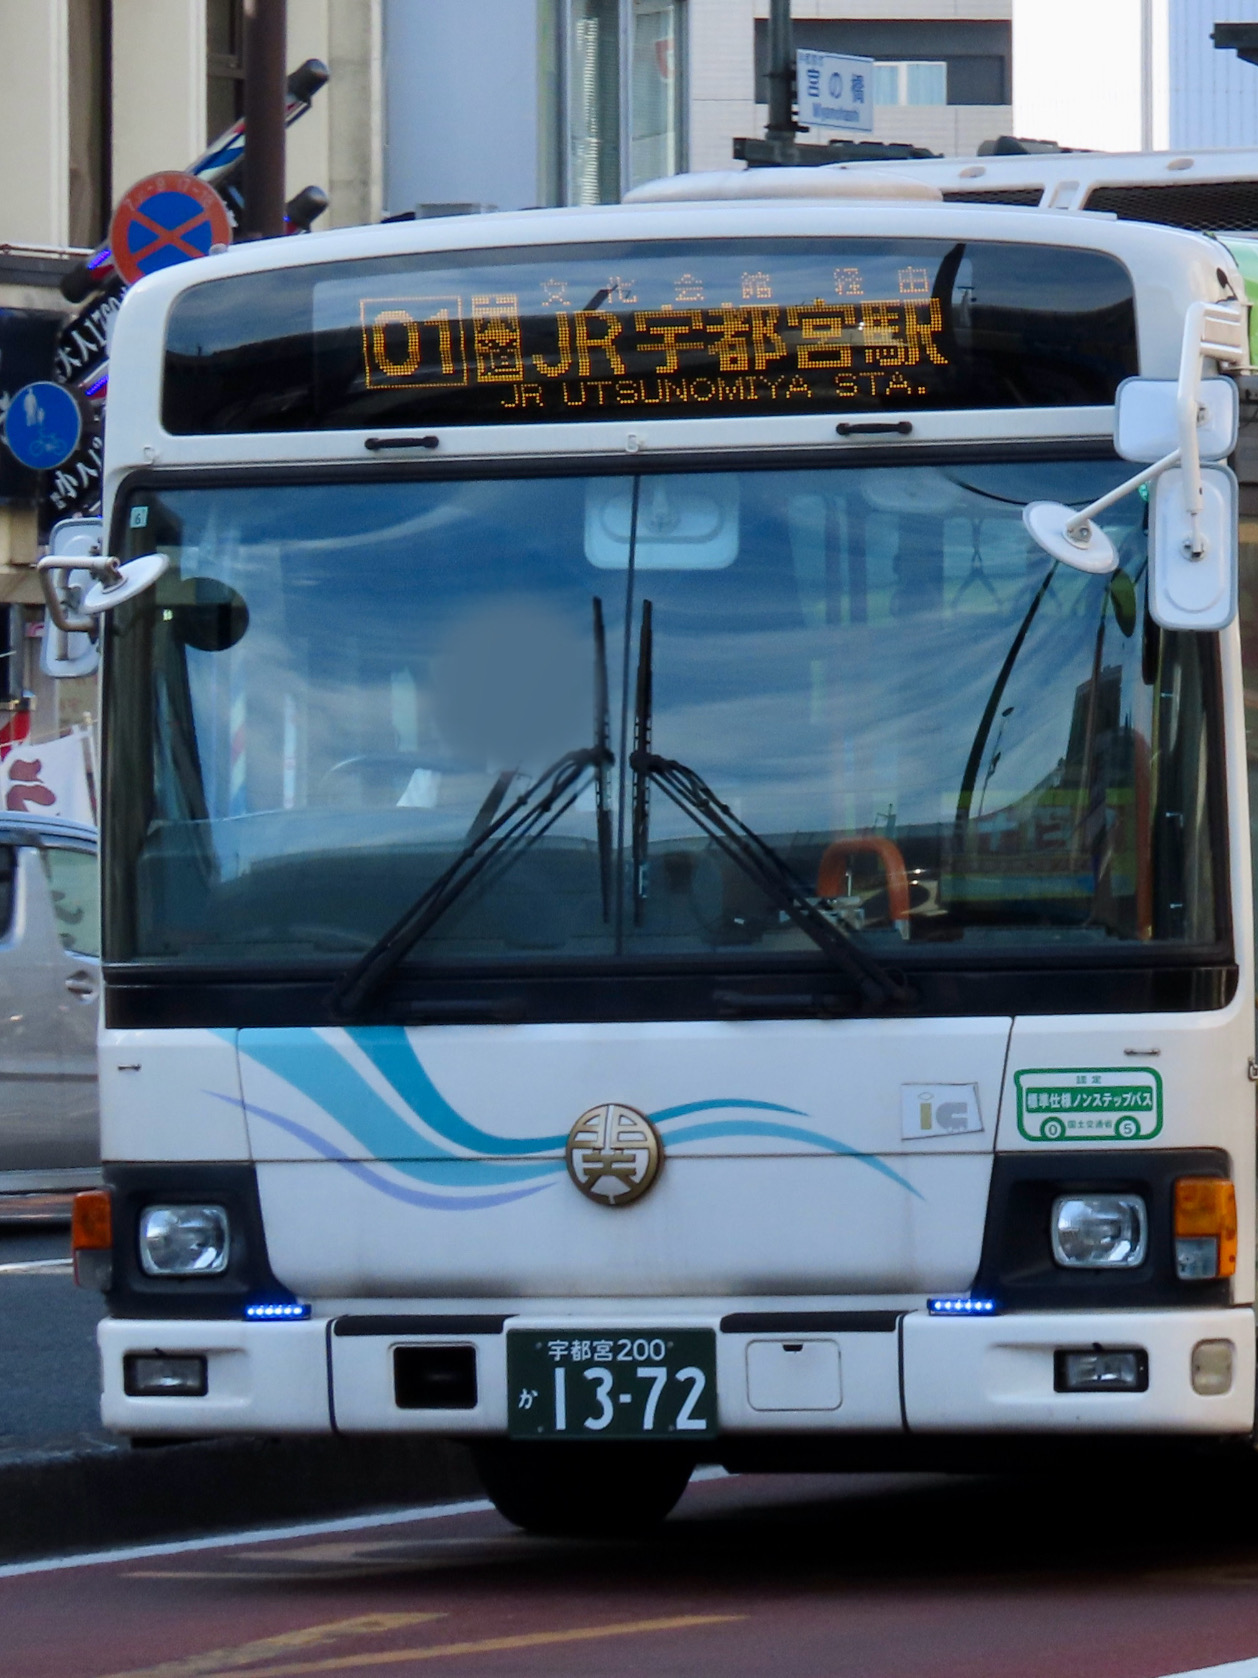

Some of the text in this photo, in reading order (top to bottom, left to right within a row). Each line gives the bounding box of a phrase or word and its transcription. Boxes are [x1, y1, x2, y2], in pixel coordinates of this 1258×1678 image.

[834, 265, 929, 295] 経由
[373, 309, 455, 377] 01
[532, 297, 949, 378] JR宇都宮駅
[501, 371, 926, 408] JR UTSUNOMIYA STA.
[518, 1366, 708, 1430] か 13-72
